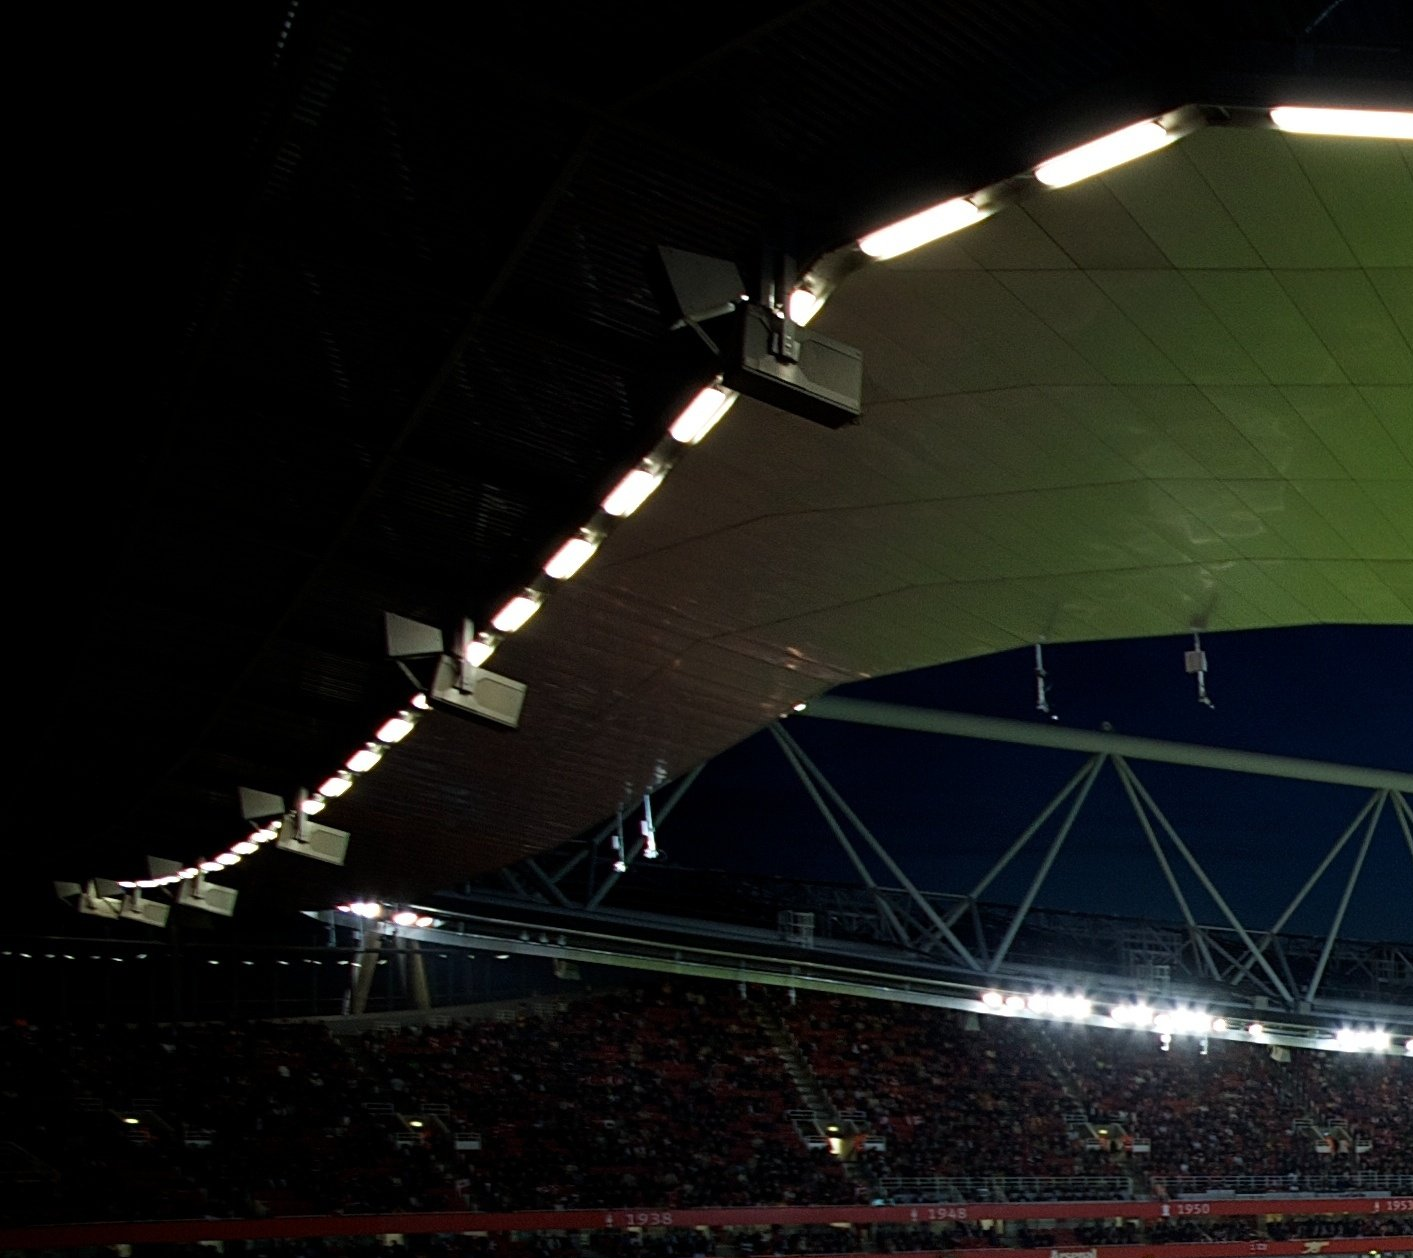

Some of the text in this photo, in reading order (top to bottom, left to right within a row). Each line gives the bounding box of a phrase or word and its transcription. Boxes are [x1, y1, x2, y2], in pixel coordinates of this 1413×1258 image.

[928, 1207, 968, 1220] 1948
[1178, 1203, 1211, 1215] 1950
[625, 1211, 673, 1226] 1938
